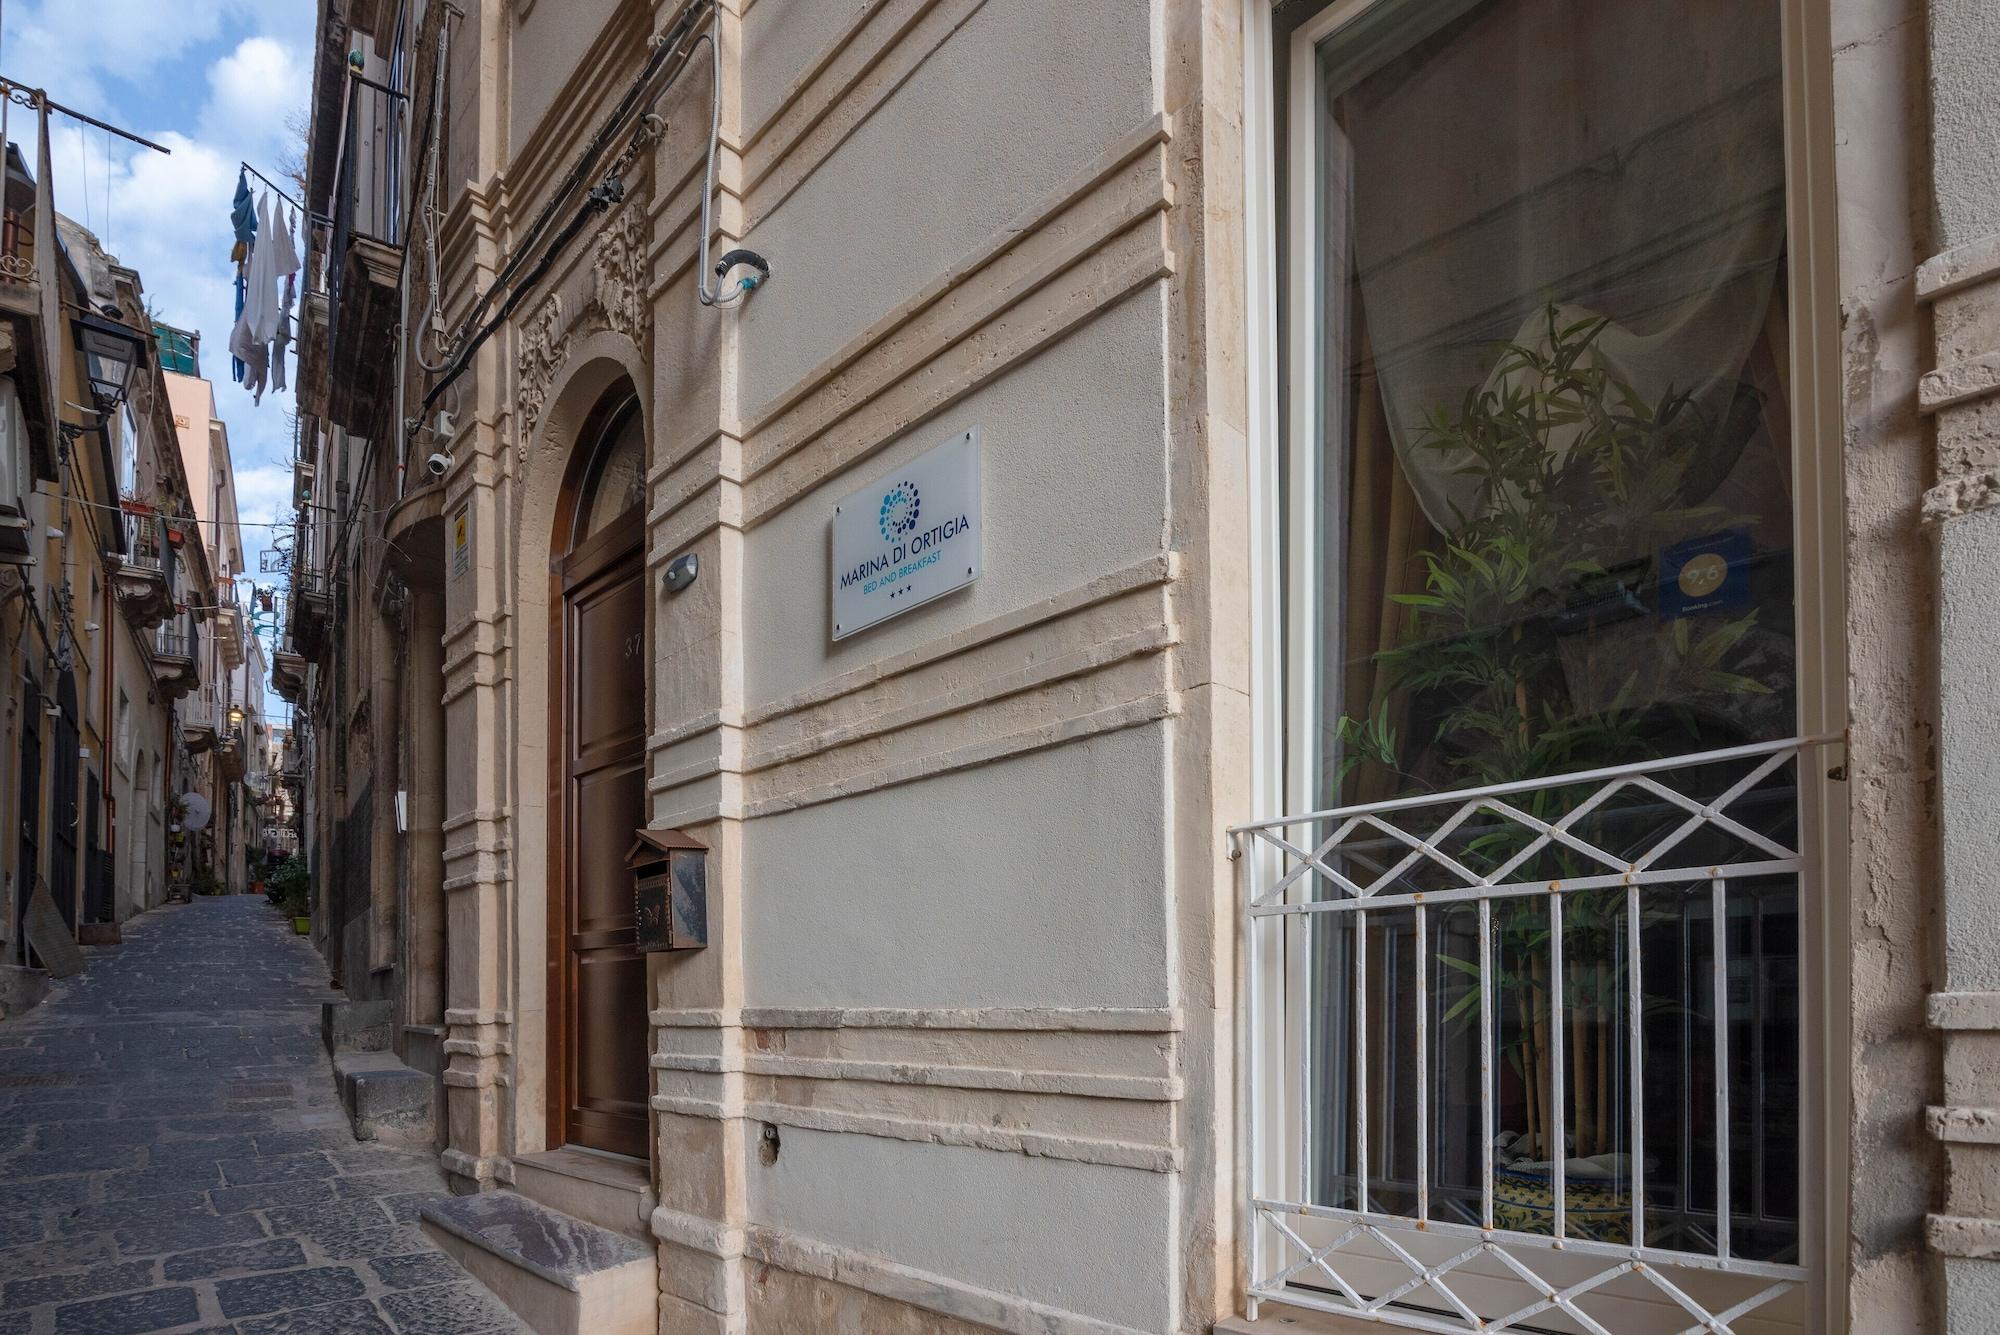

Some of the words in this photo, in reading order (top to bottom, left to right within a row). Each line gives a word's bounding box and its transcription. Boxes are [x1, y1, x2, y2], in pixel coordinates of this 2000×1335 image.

[840, 554, 889, 590] MARINA
[893, 543, 907, 564] DI
[911, 514, 970, 554] ORTIGIA
[863, 580, 878, 595] BED
[879, 571, 897, 587] AND
[898, 550, 942, 579] BREAKFAST
[1681, 599, 1724, 613] Booking.com
[625, 632, 642, 657] 37
